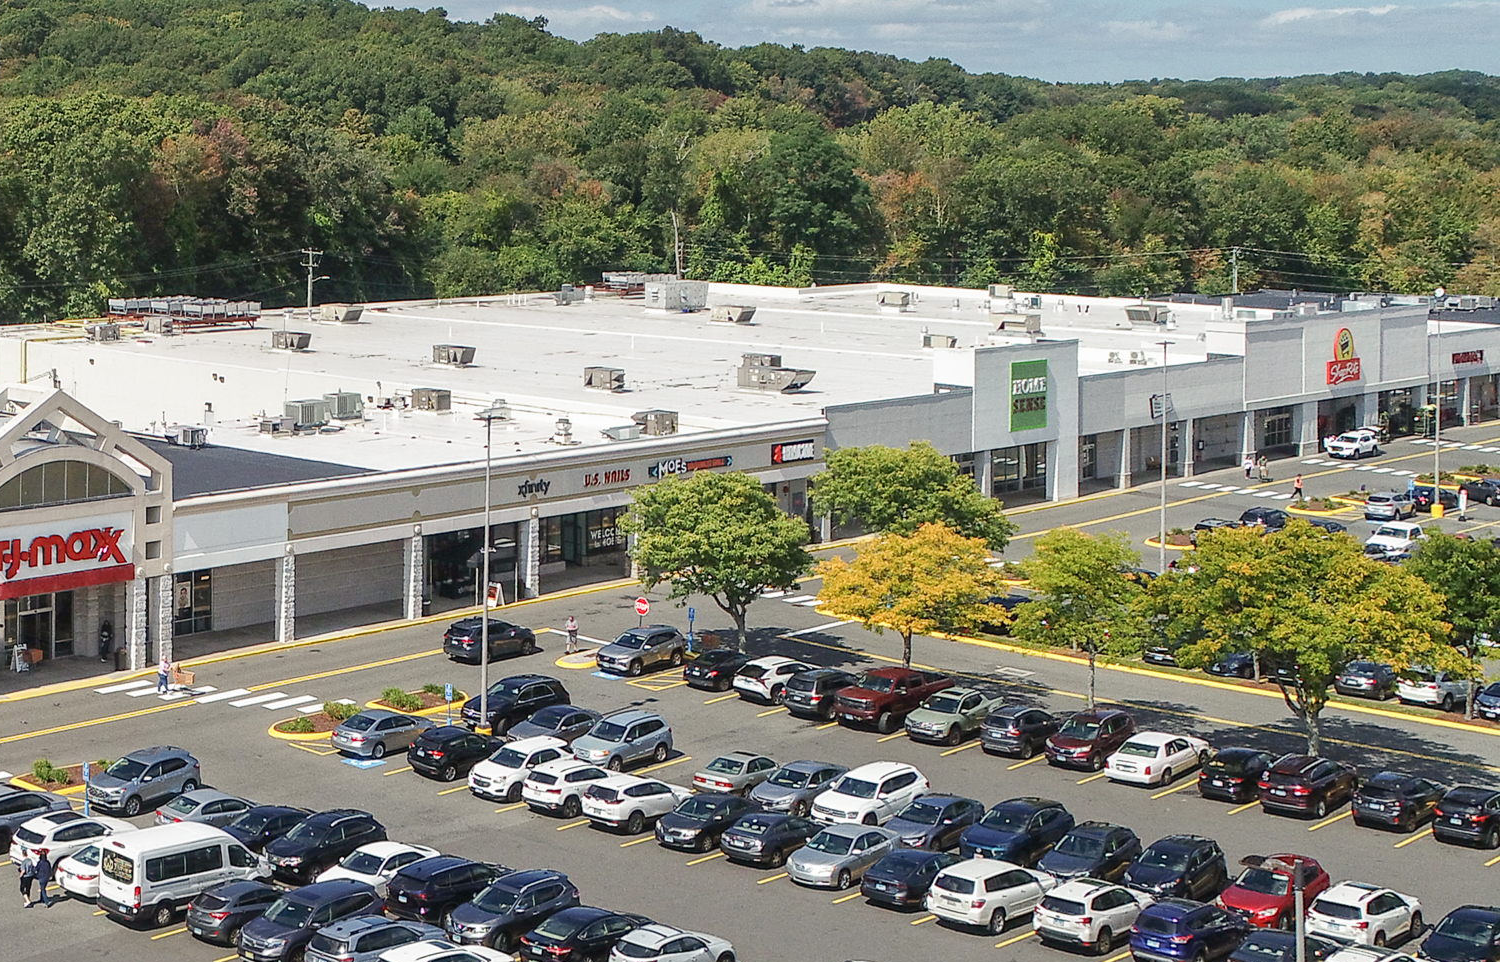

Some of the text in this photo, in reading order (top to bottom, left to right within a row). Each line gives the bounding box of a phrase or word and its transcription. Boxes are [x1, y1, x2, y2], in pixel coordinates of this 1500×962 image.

[1012, 376, 1046, 395] HOME
[1012, 396, 1046, 414] SENSE
[584, 469, 630, 487] U.S. NAILS
[517, 479, 551, 498] xfinity
